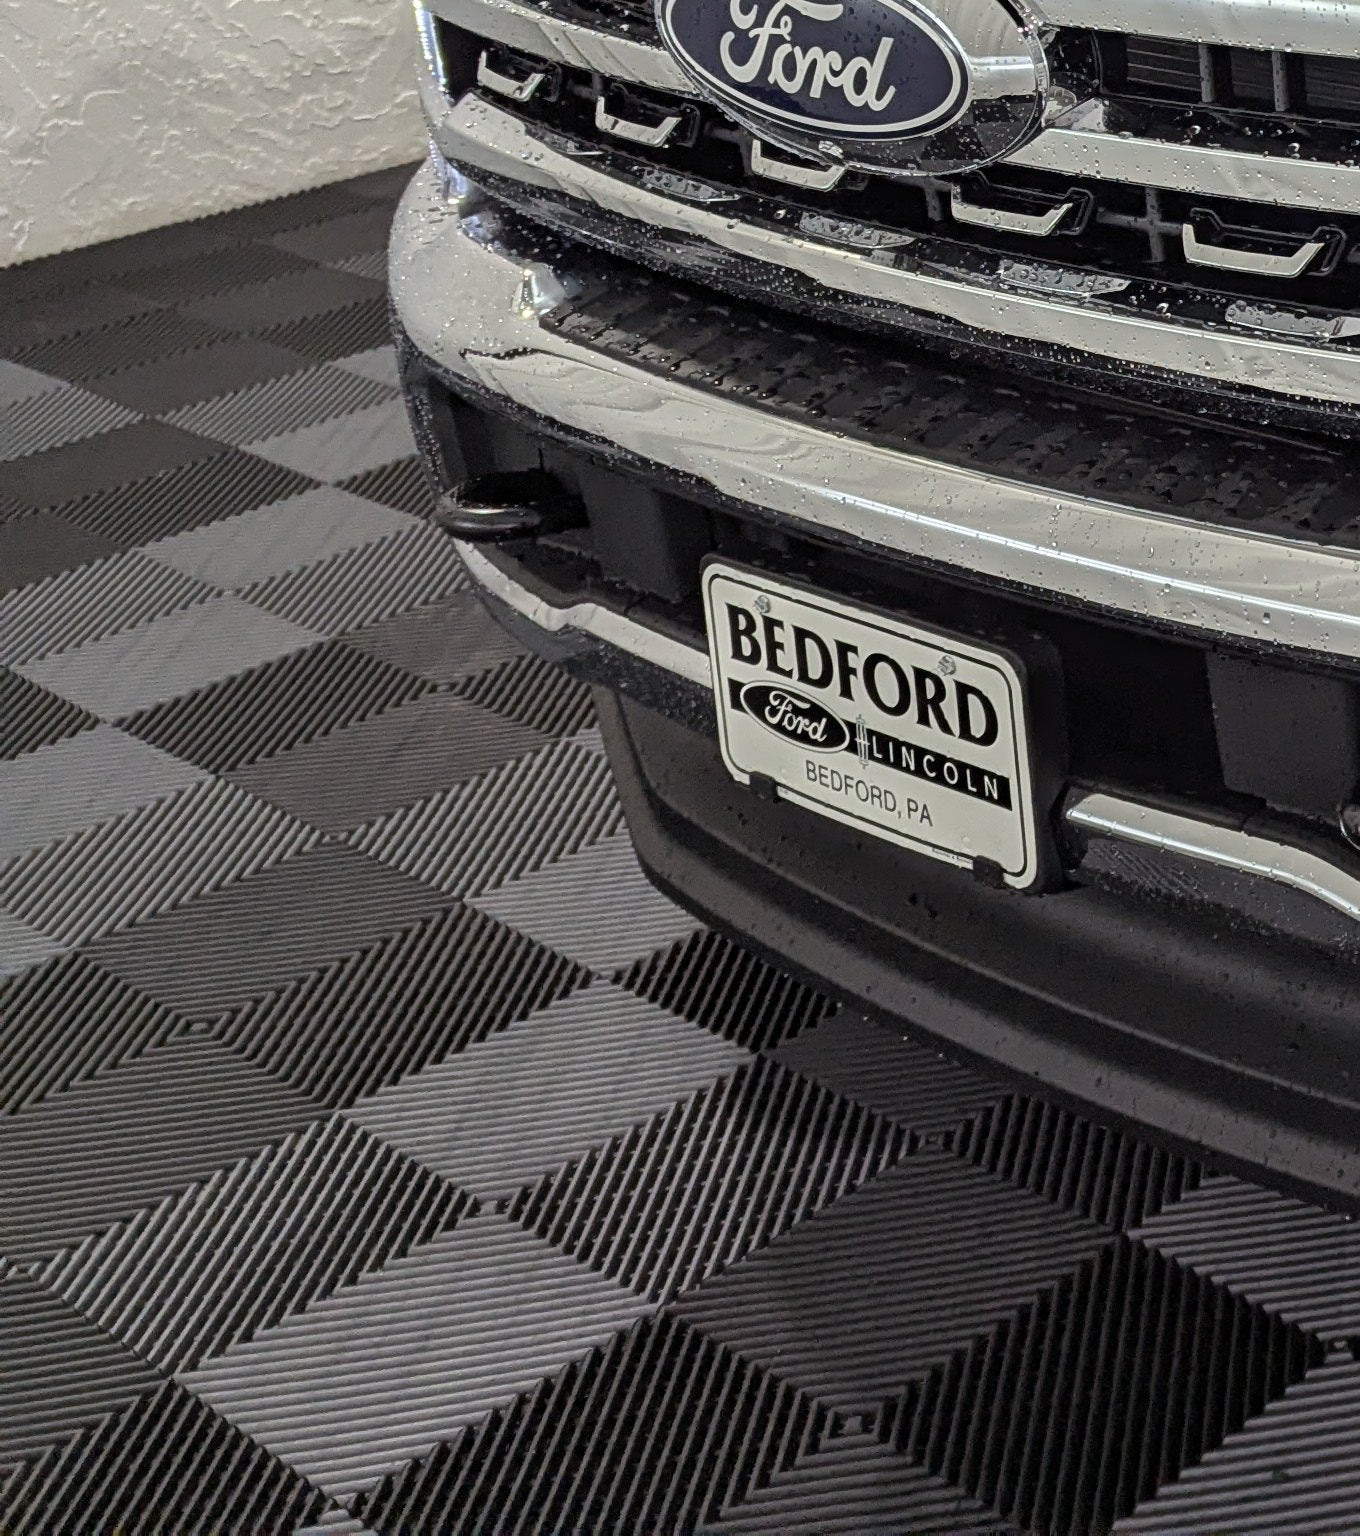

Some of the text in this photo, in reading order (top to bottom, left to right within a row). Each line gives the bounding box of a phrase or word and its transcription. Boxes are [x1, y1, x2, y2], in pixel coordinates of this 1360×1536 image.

[725, 602, 1000, 748] BEDFORD
[764, 689, 1000, 801] Ford LINCOLN
[804, 759, 934, 828] BEDFORD, PA
